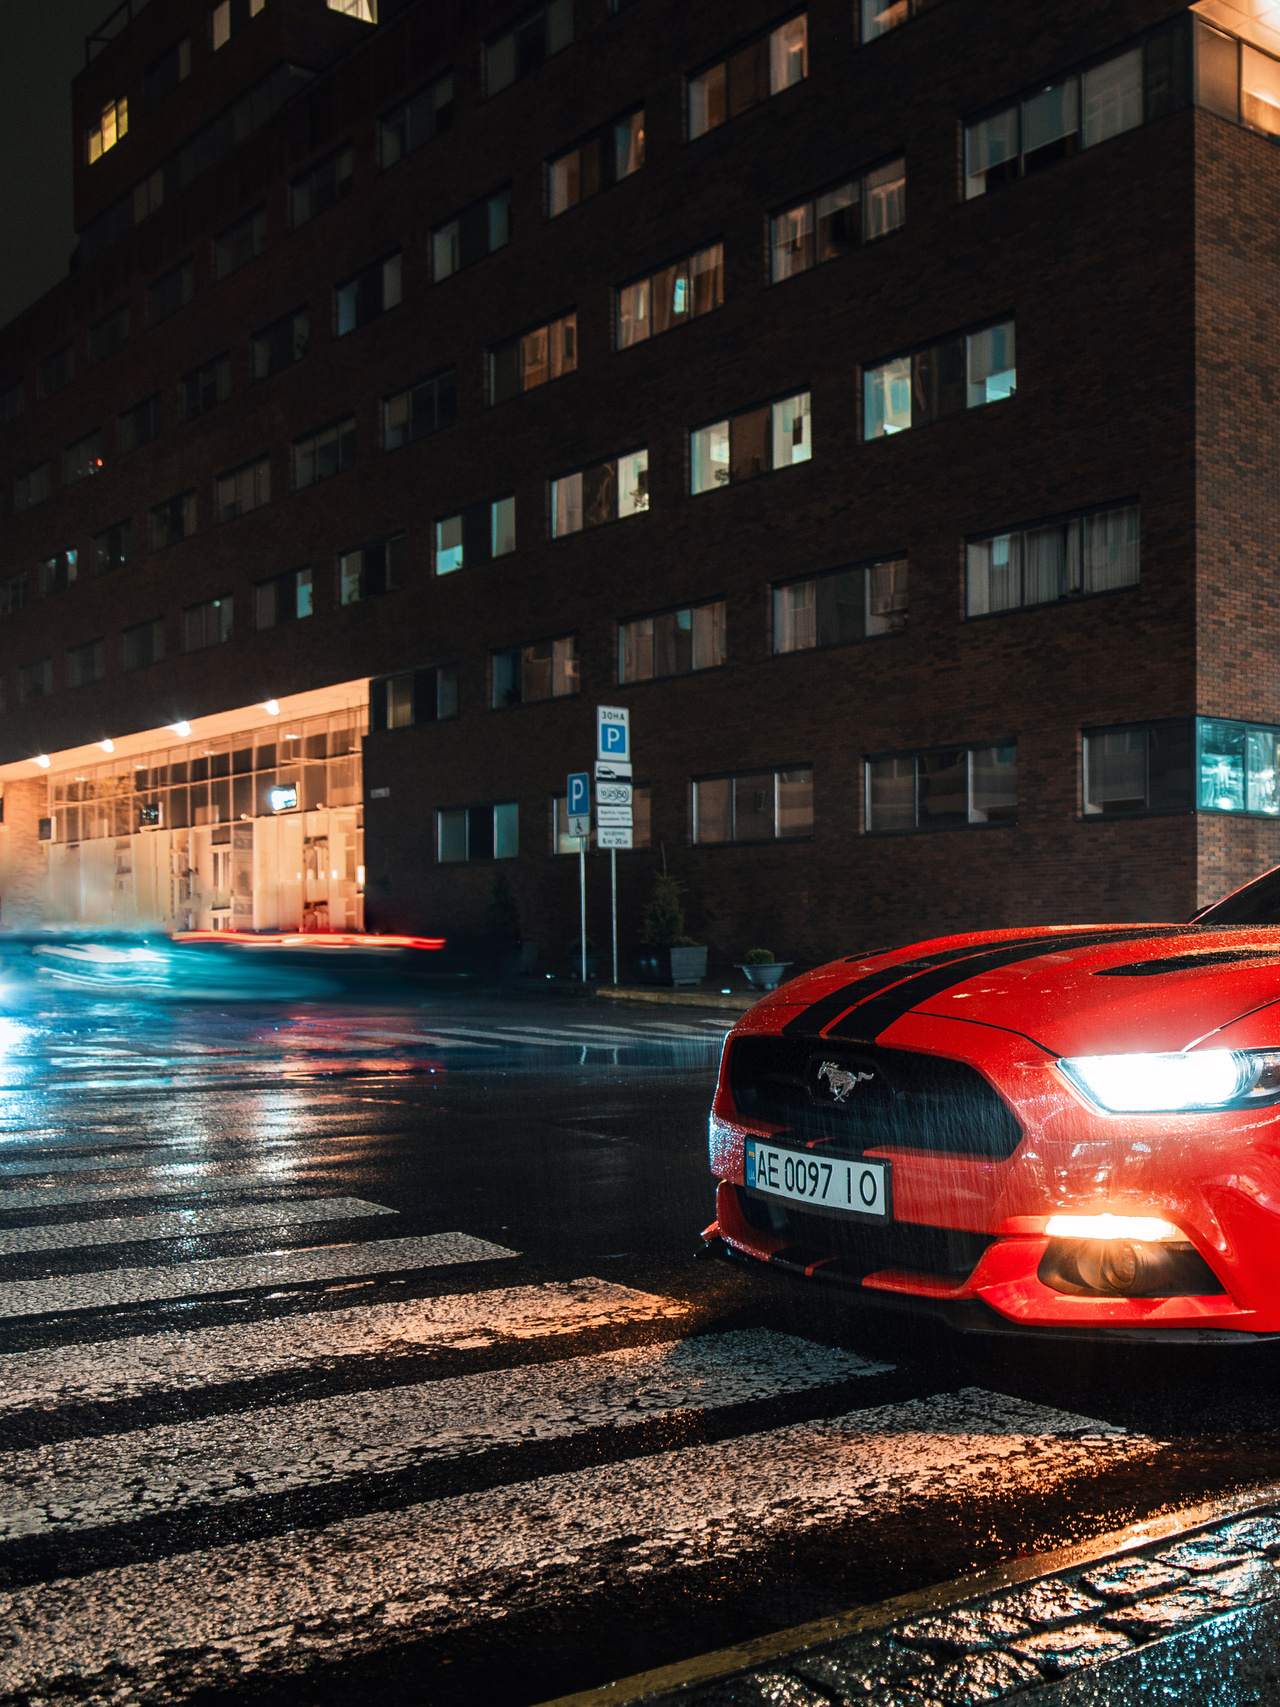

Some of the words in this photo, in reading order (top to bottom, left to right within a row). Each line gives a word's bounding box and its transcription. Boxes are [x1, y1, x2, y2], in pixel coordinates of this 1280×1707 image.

[601, 710, 625, 721] ЗОНА
[607, 727, 620, 750] P
[572, 778, 584, 812] P
[617, 790, 627, 800] 50
[757, 1150, 780, 1189] AE
[784, 1156, 833, 1199] 0097
